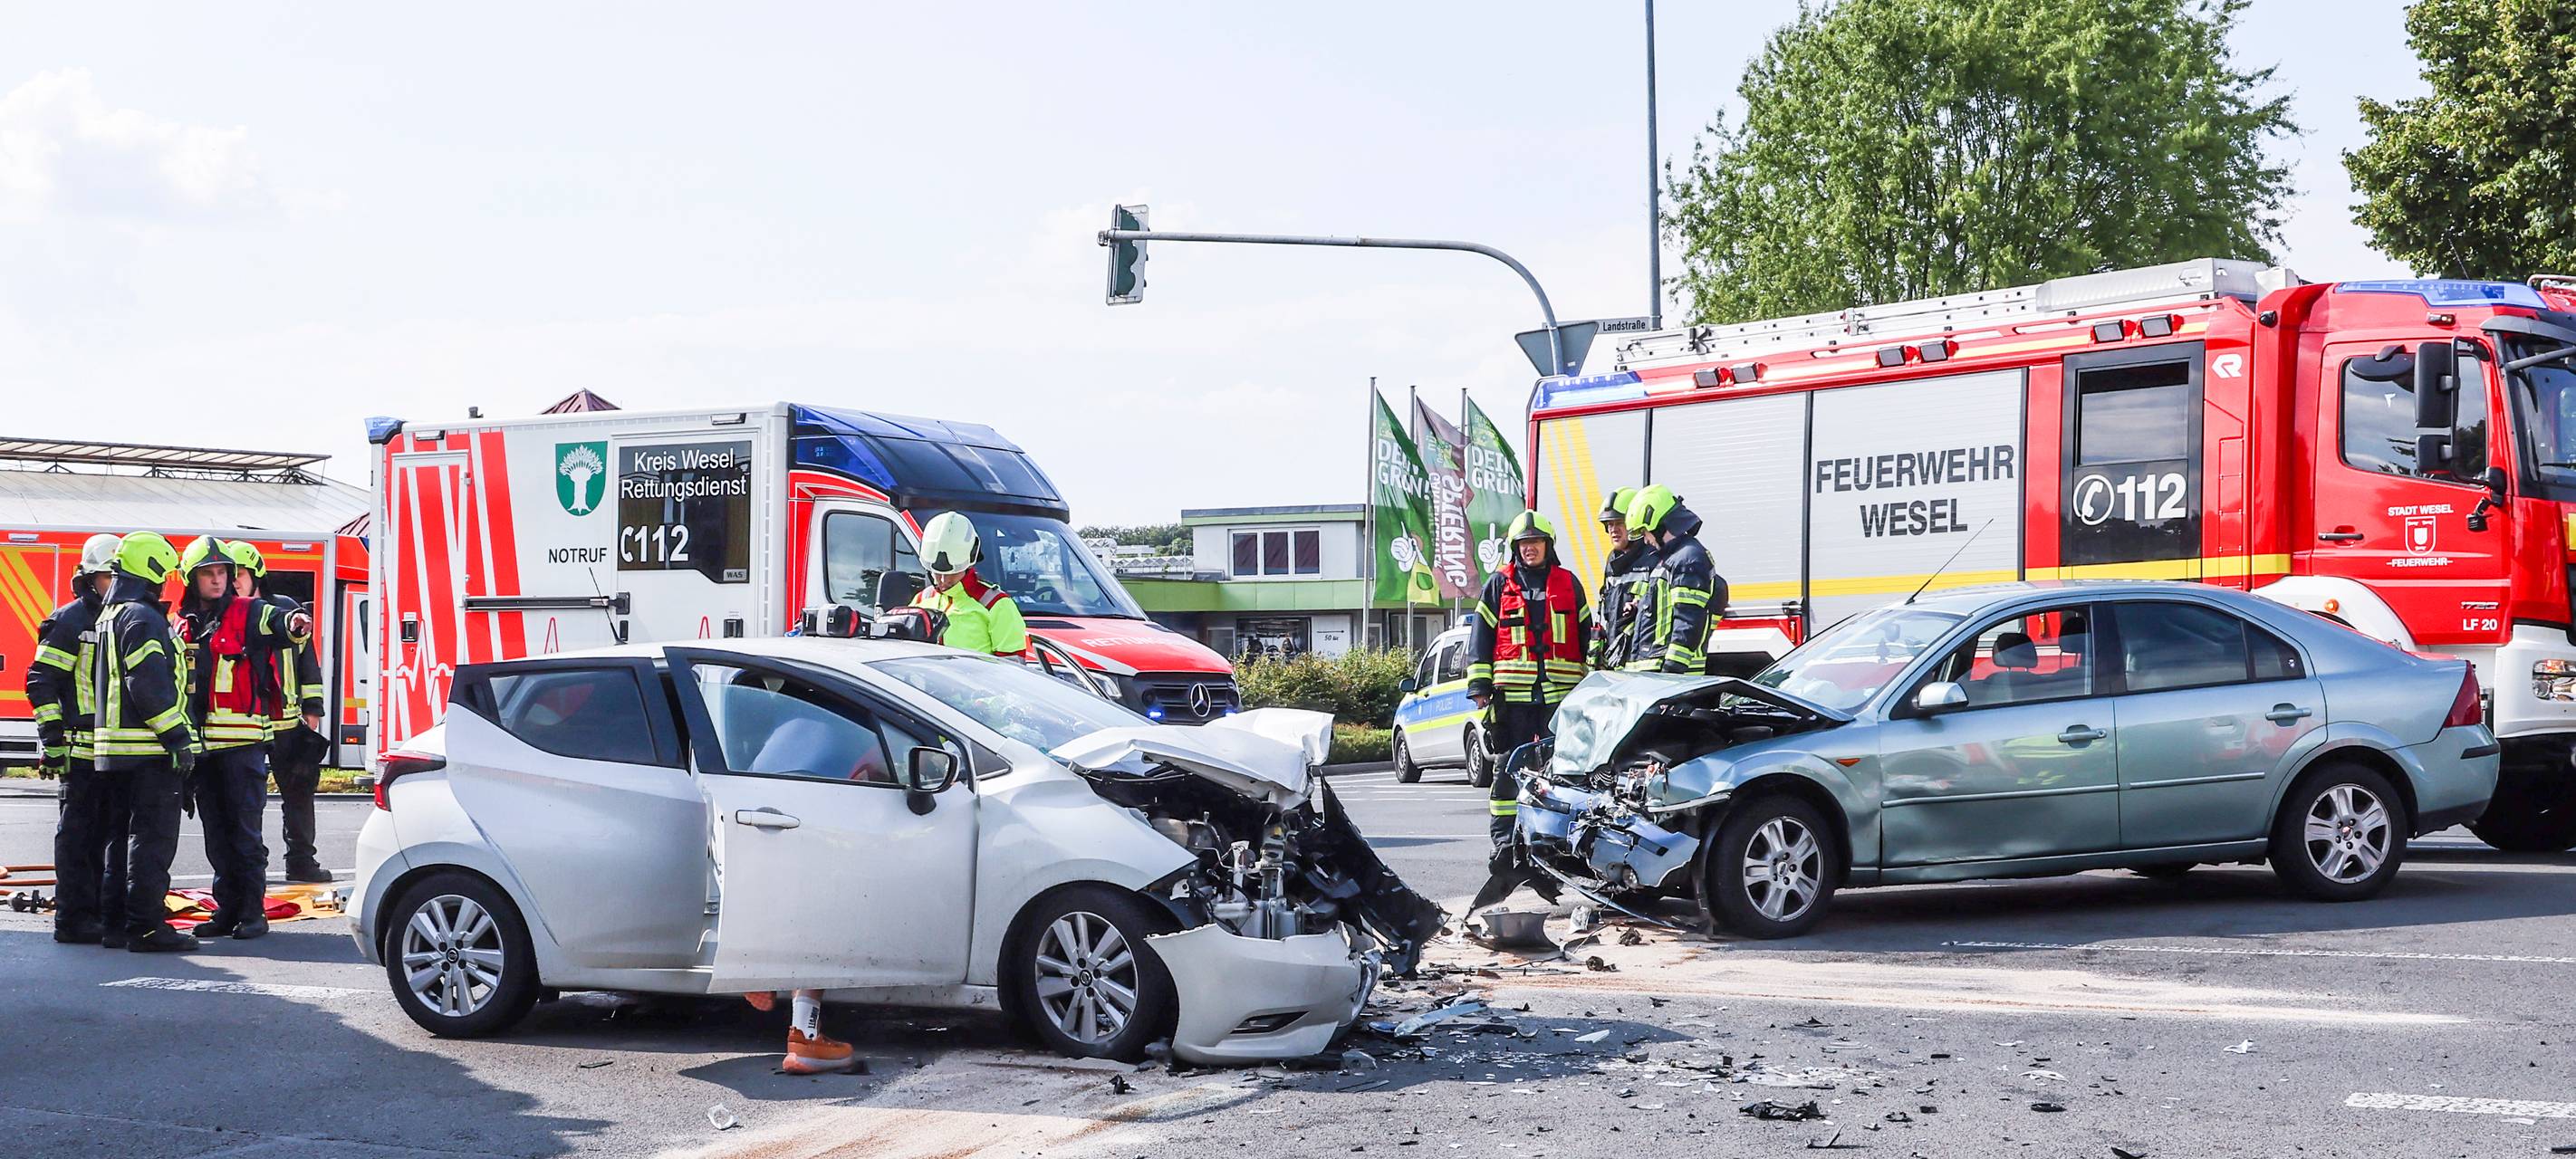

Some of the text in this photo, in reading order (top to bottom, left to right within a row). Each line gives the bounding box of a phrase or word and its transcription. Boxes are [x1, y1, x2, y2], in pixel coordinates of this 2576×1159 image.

[1602, 319, 1646, 331] Landstraße
[634, 448, 734, 472] Kreis Wesel
[1816, 445, 2014, 493] FEUERWEHR
[621, 475, 747, 503] Rettungsdienst
[2116, 472, 2187, 522] 112
[1860, 498, 1968, 538] WESEL
[2388, 503, 2454, 516] STADT WESEL
[548, 547, 608, 564] NOTRUF
[726, 570, 743, 579] WAS
[2463, 619, 2497, 631] LF 20
